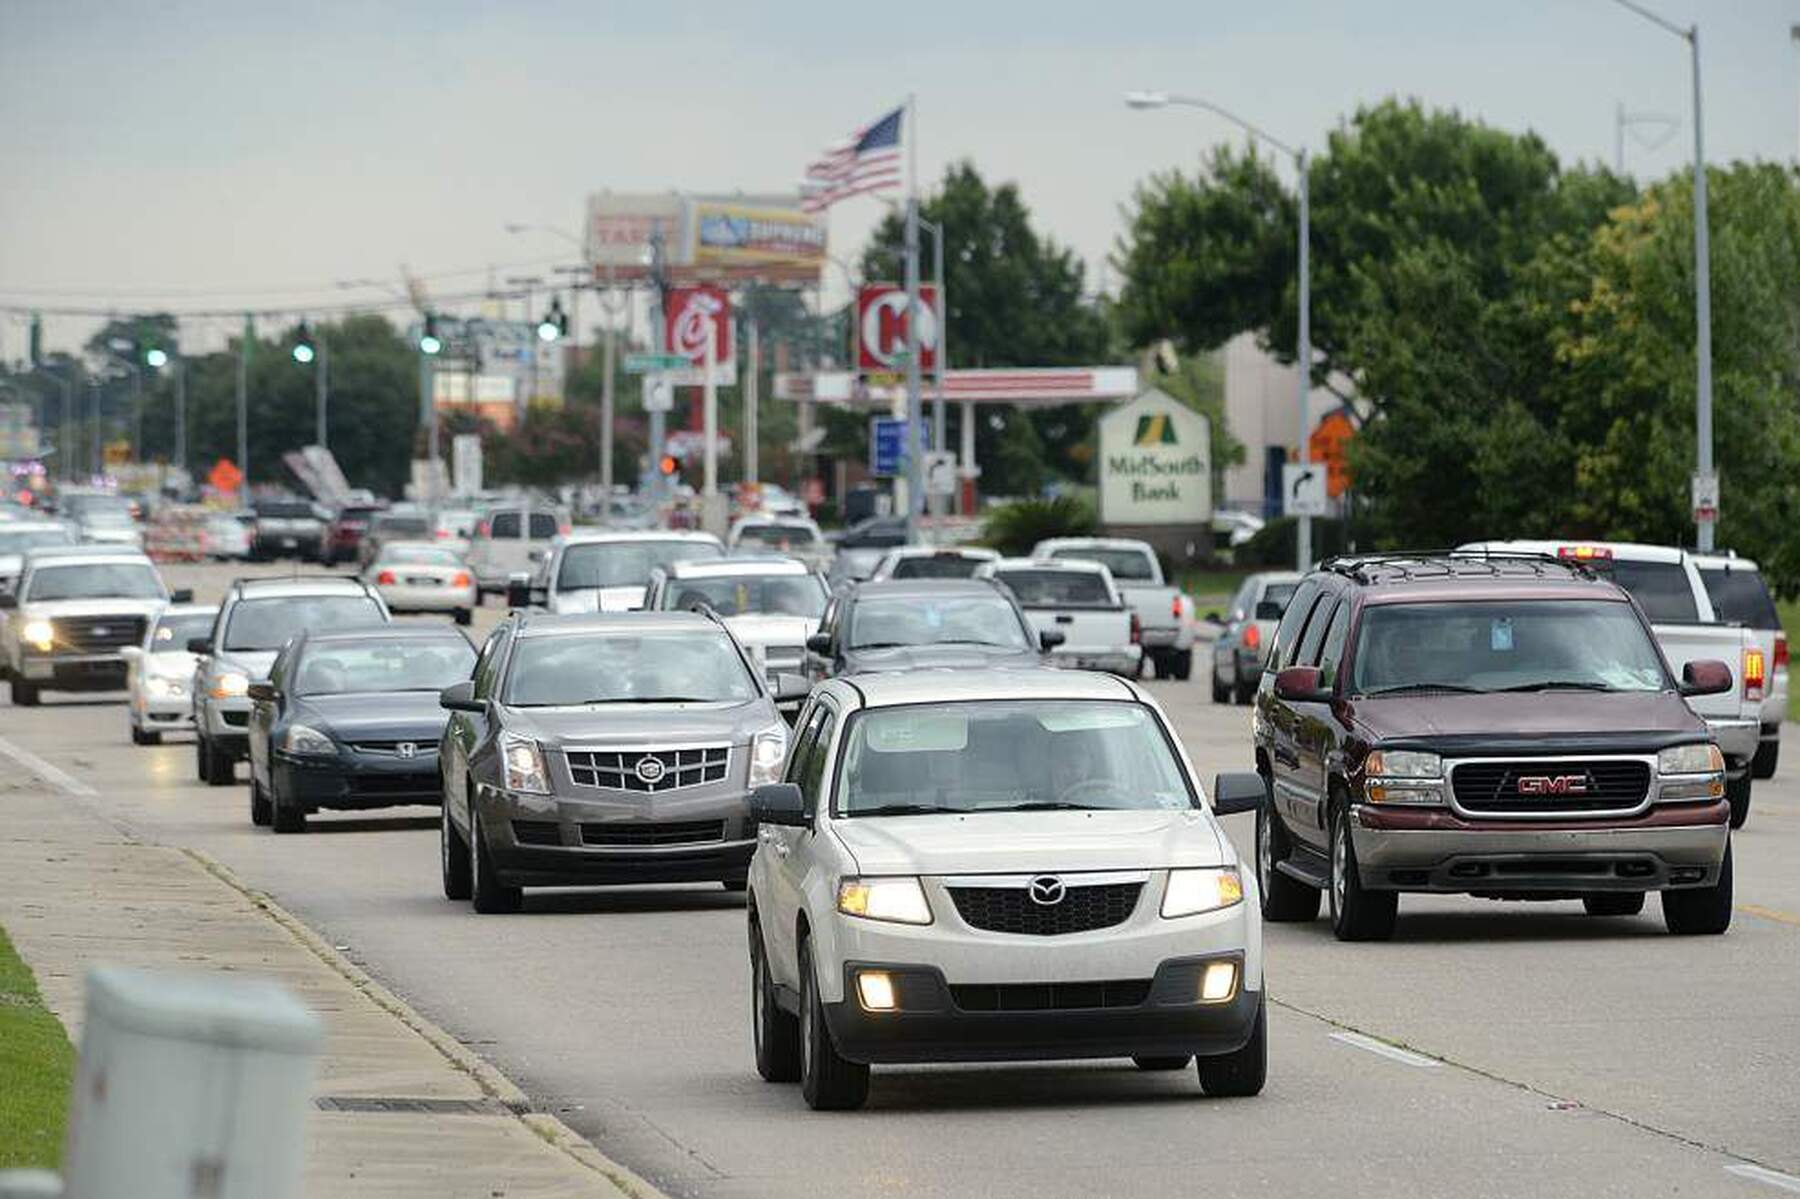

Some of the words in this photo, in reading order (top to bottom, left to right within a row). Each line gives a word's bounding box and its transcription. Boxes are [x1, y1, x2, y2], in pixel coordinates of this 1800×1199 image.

[1109, 455, 1203, 475] MidSouth
[1132, 480, 1180, 501] Bank
[1518, 775, 1587, 794] GMC
